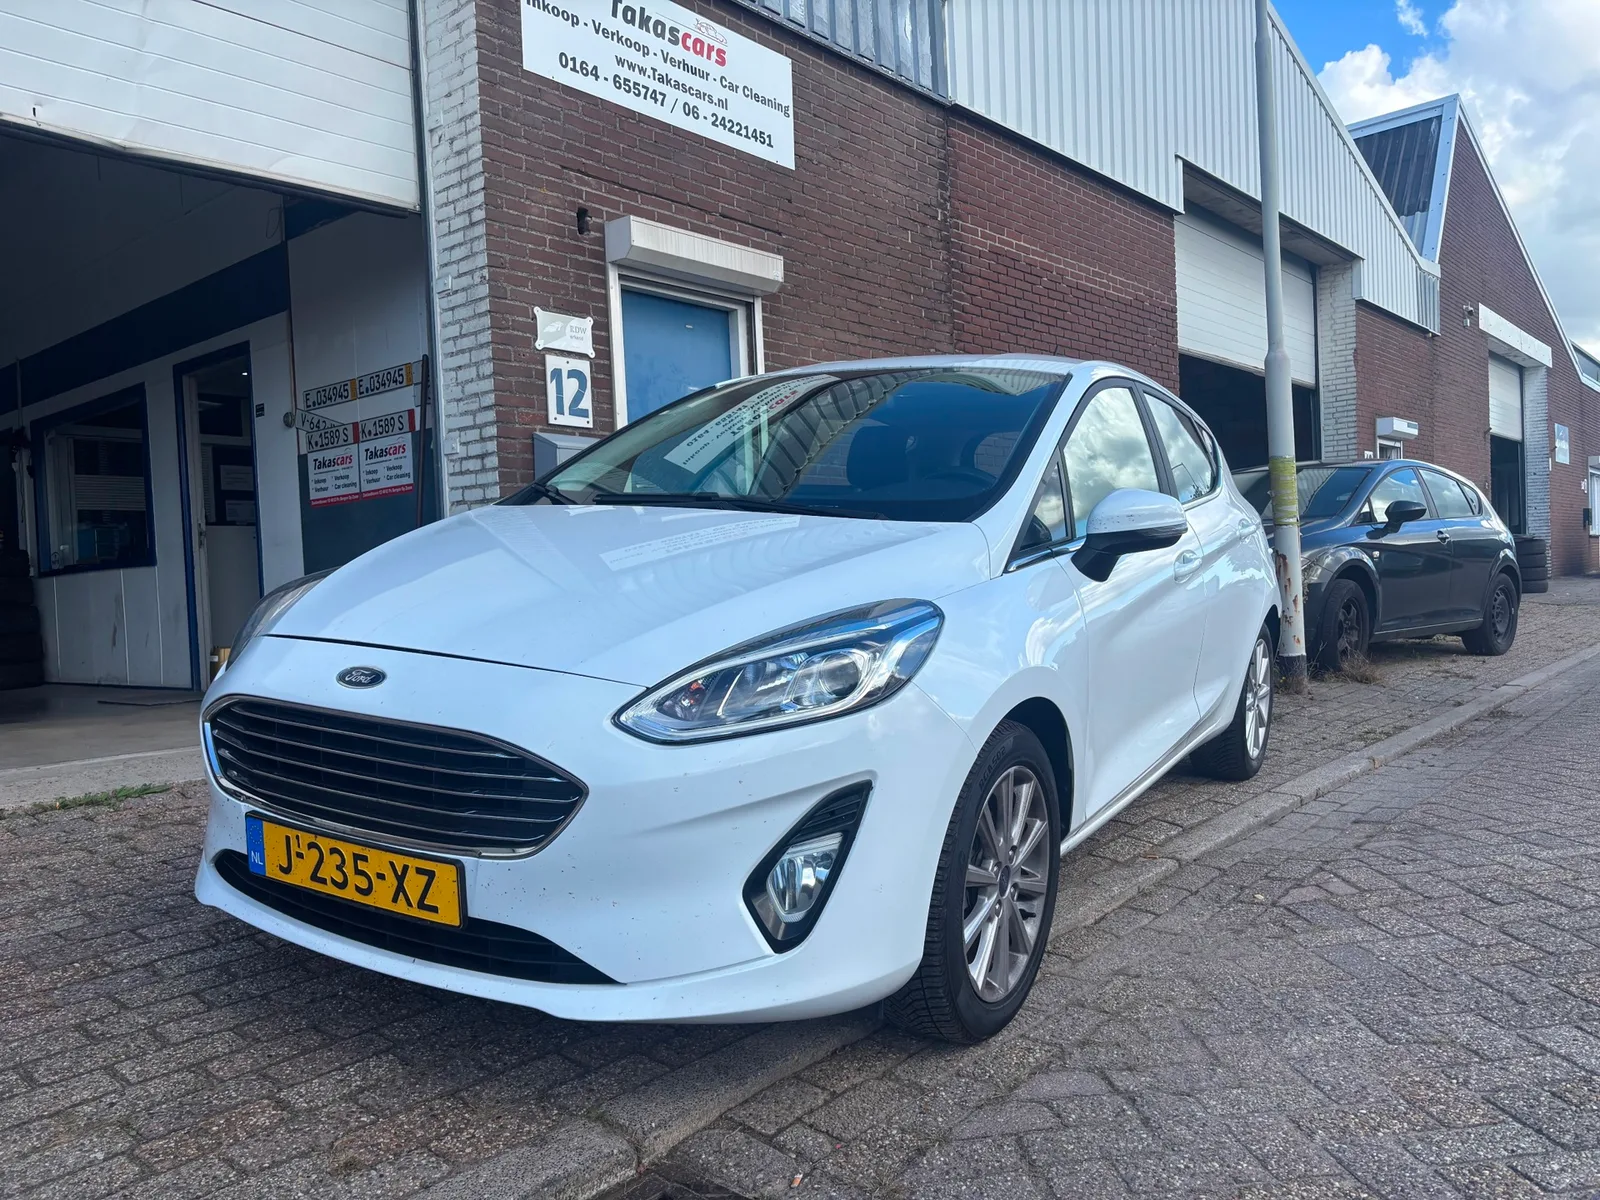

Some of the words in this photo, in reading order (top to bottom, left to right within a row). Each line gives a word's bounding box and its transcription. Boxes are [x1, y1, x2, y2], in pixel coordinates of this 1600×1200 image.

[610, 0, 727, 67] Takascars
[592, 19, 650, 57] Verkoop
[660, 48, 710, 82] Verhuur
[720, 75, 740, 94] Car
[743, 87, 790, 118] Cleaning
[615, 54, 729, 111] www.Takascars.nl
[558, 52, 600, 82] 0164
[612, 75, 667, 107] 655747
[682, 101, 700, 120] 06
[711, 113, 774, 148] 24221451
[550, 367, 589, 418] 12
[312, 454, 353, 470] Takascars
[364, 443, 407, 461] Takascars
[345, 669, 373, 684] Ford
[251, 850, 264, 866] NL
